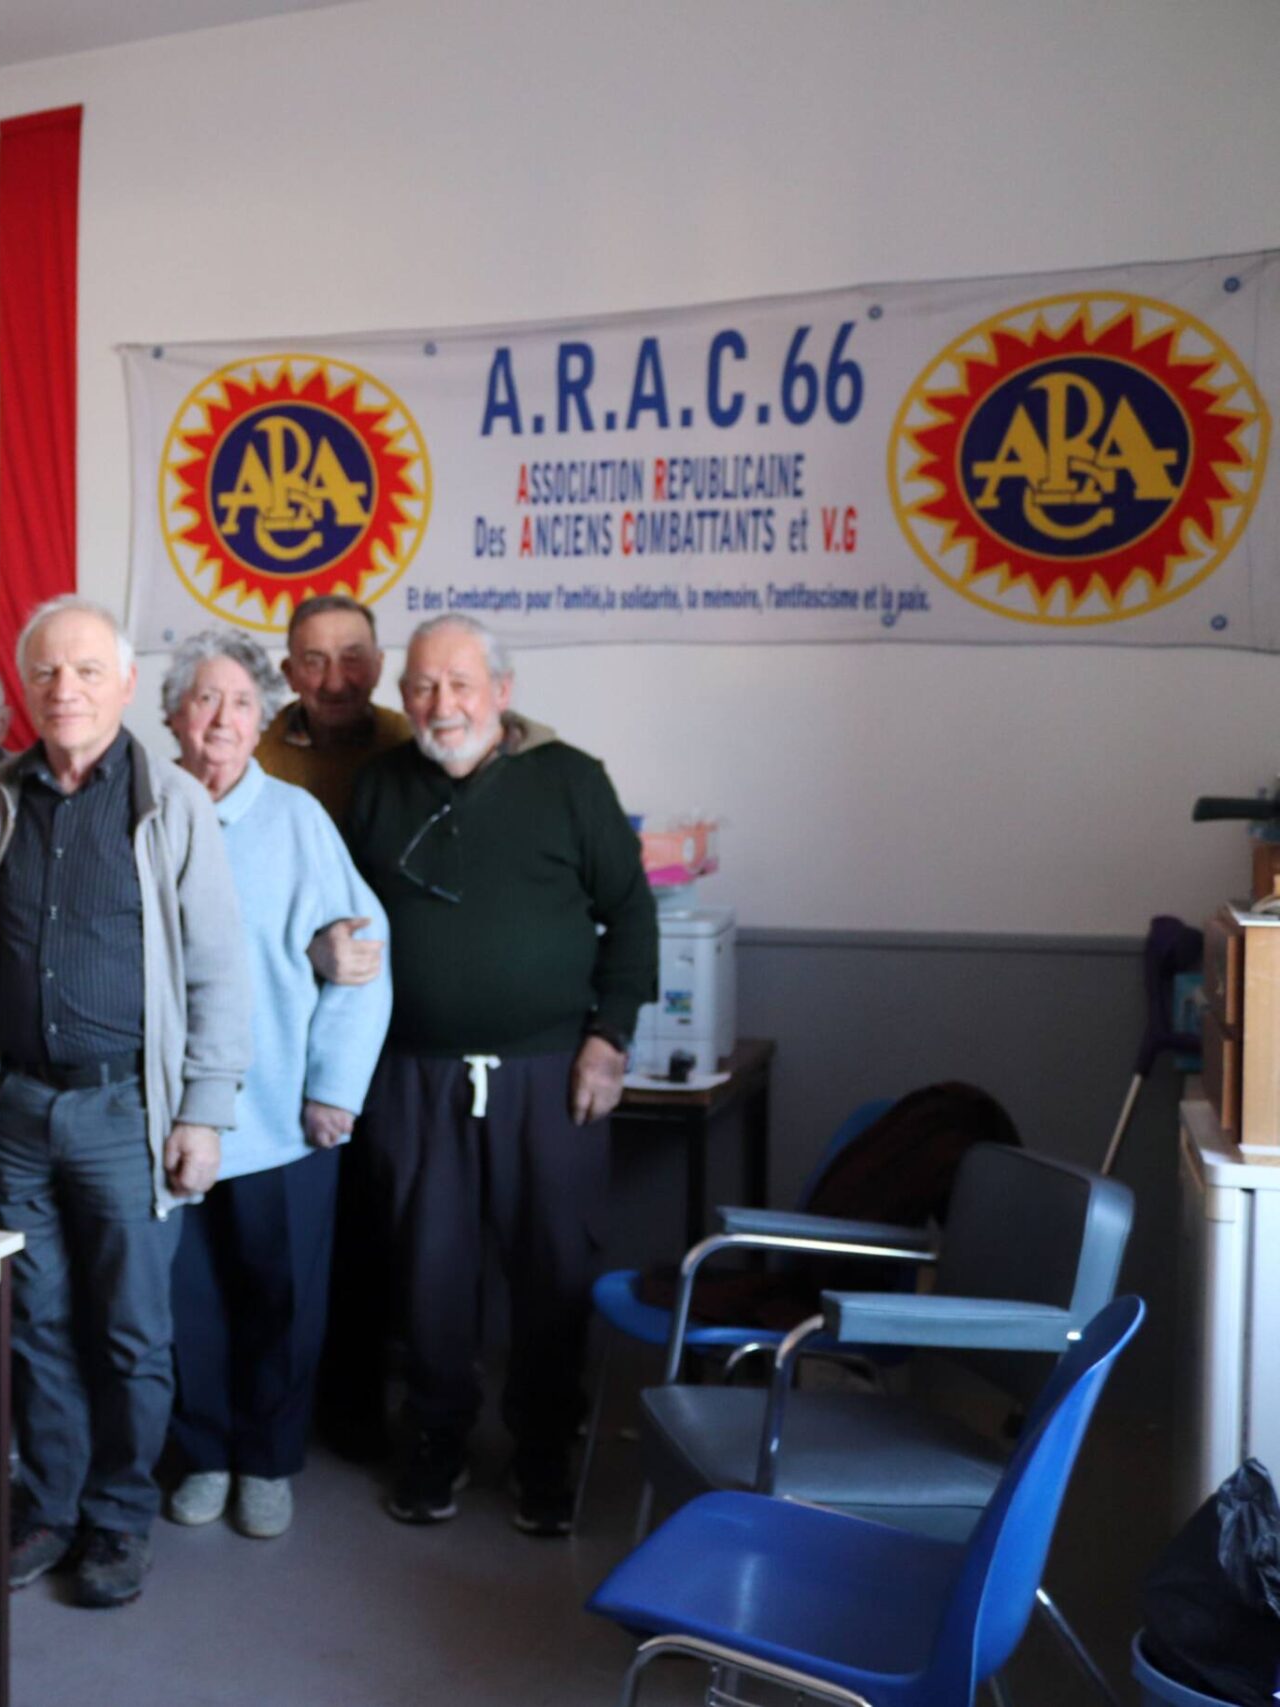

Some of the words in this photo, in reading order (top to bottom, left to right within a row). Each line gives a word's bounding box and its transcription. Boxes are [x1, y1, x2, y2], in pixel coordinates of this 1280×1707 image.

[481, 321, 864, 437] A.R.A.C.66
[517, 459, 645, 505] ASSOCIATION
[653, 453, 805, 502] REPUBLICAINE
[474, 516, 506, 558] Des
[519, 512, 613, 558] ANCIENS
[622, 508, 776, 557] COMBATTANTS
[788, 513, 809, 553] et
